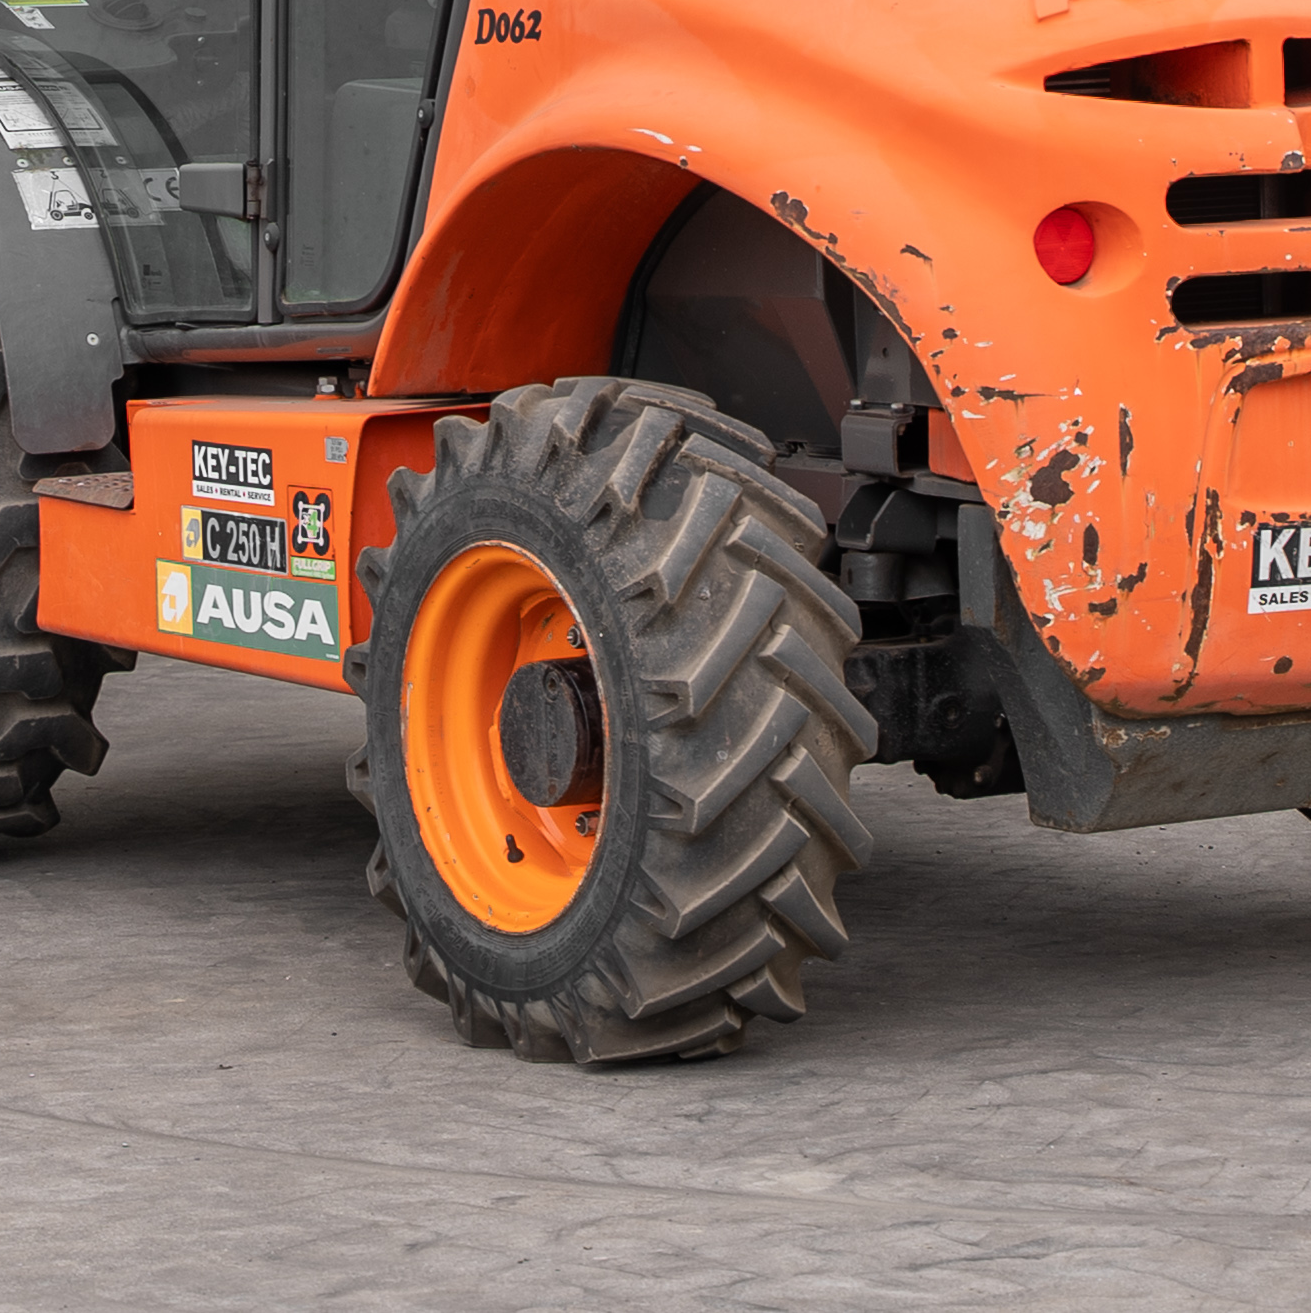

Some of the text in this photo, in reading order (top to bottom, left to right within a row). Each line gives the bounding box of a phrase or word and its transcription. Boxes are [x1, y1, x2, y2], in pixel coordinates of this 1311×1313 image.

[194, 444, 272, 486] KEY-TEC
[196, 484, 272, 502] SALES RENTAL SERVICE
[206, 517, 282, 568] C 250 H
[196, 584, 336, 646] AUSA
[1258, 590, 1310, 607] SALES
